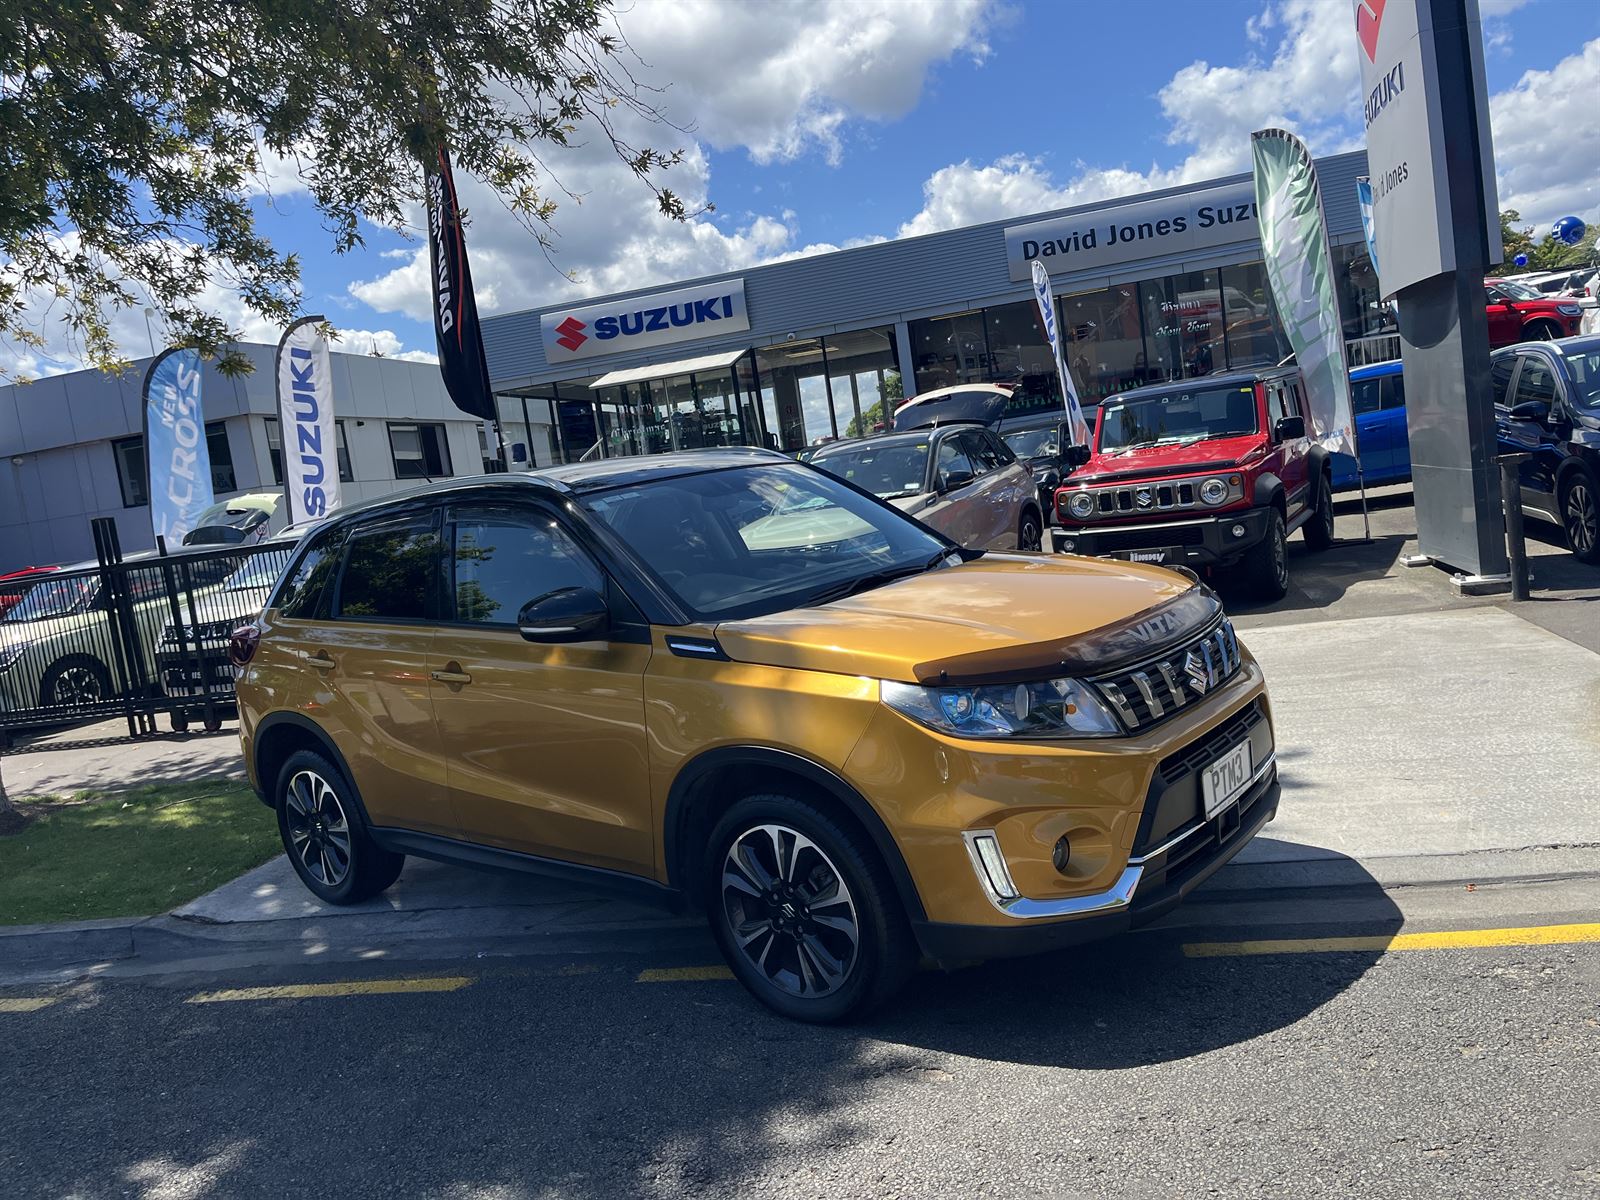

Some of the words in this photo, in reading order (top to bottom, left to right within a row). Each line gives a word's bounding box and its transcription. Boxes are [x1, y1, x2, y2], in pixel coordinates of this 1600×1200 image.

[1385, 161, 1408, 194] Jones
[1022, 228, 1097, 261] David
[1107, 215, 1187, 246] Jones
[594, 295, 734, 340] SUZUKI
[161, 383, 178, 429] NEW
[291, 347, 327, 517] SUZUKI
[1125, 604, 1197, 641] VITA
[1211, 752, 1243, 803] PTM3
